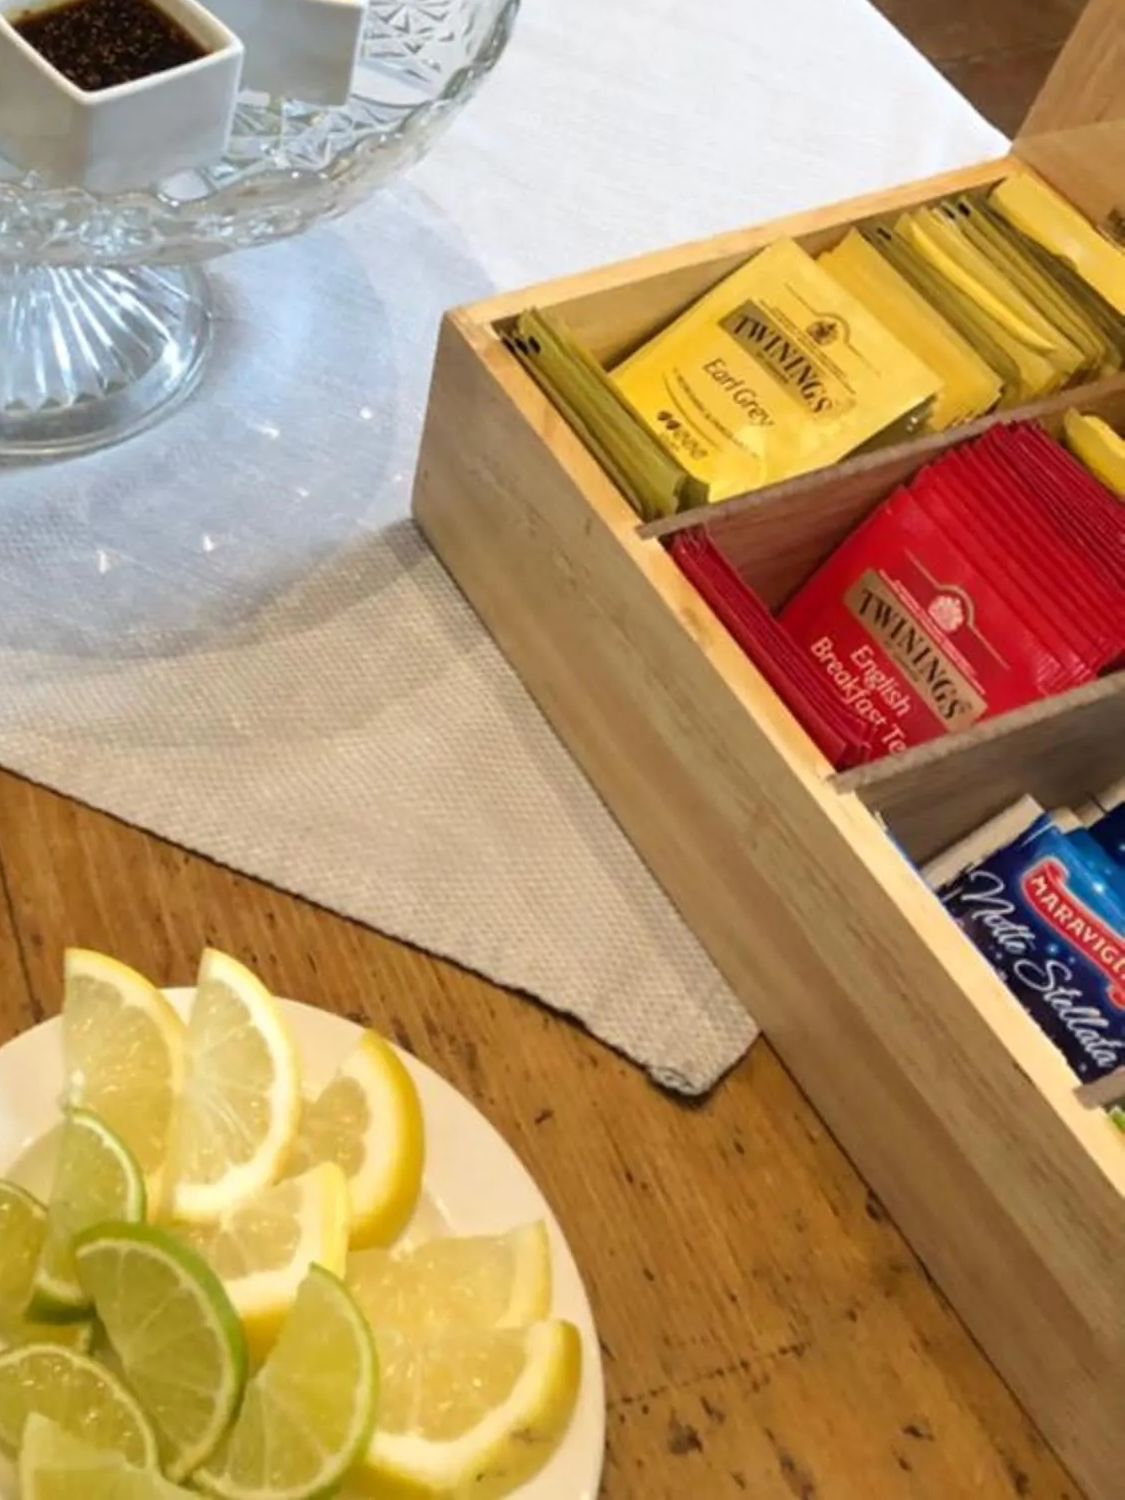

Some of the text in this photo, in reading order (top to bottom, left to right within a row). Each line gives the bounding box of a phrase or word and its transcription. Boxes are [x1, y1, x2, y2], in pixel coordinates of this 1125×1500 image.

[702, 357, 744, 391] Earl
[732, 386, 775, 427] Grey
[732, 314, 834, 414] TWININGS
[811, 636, 888, 727] Breakfast
[881, 723, 908, 756] Te
[849, 644, 911, 717] English
[857, 588, 962, 720] TWININGS
[961, 870, 1125, 1068] Notte Stellata
